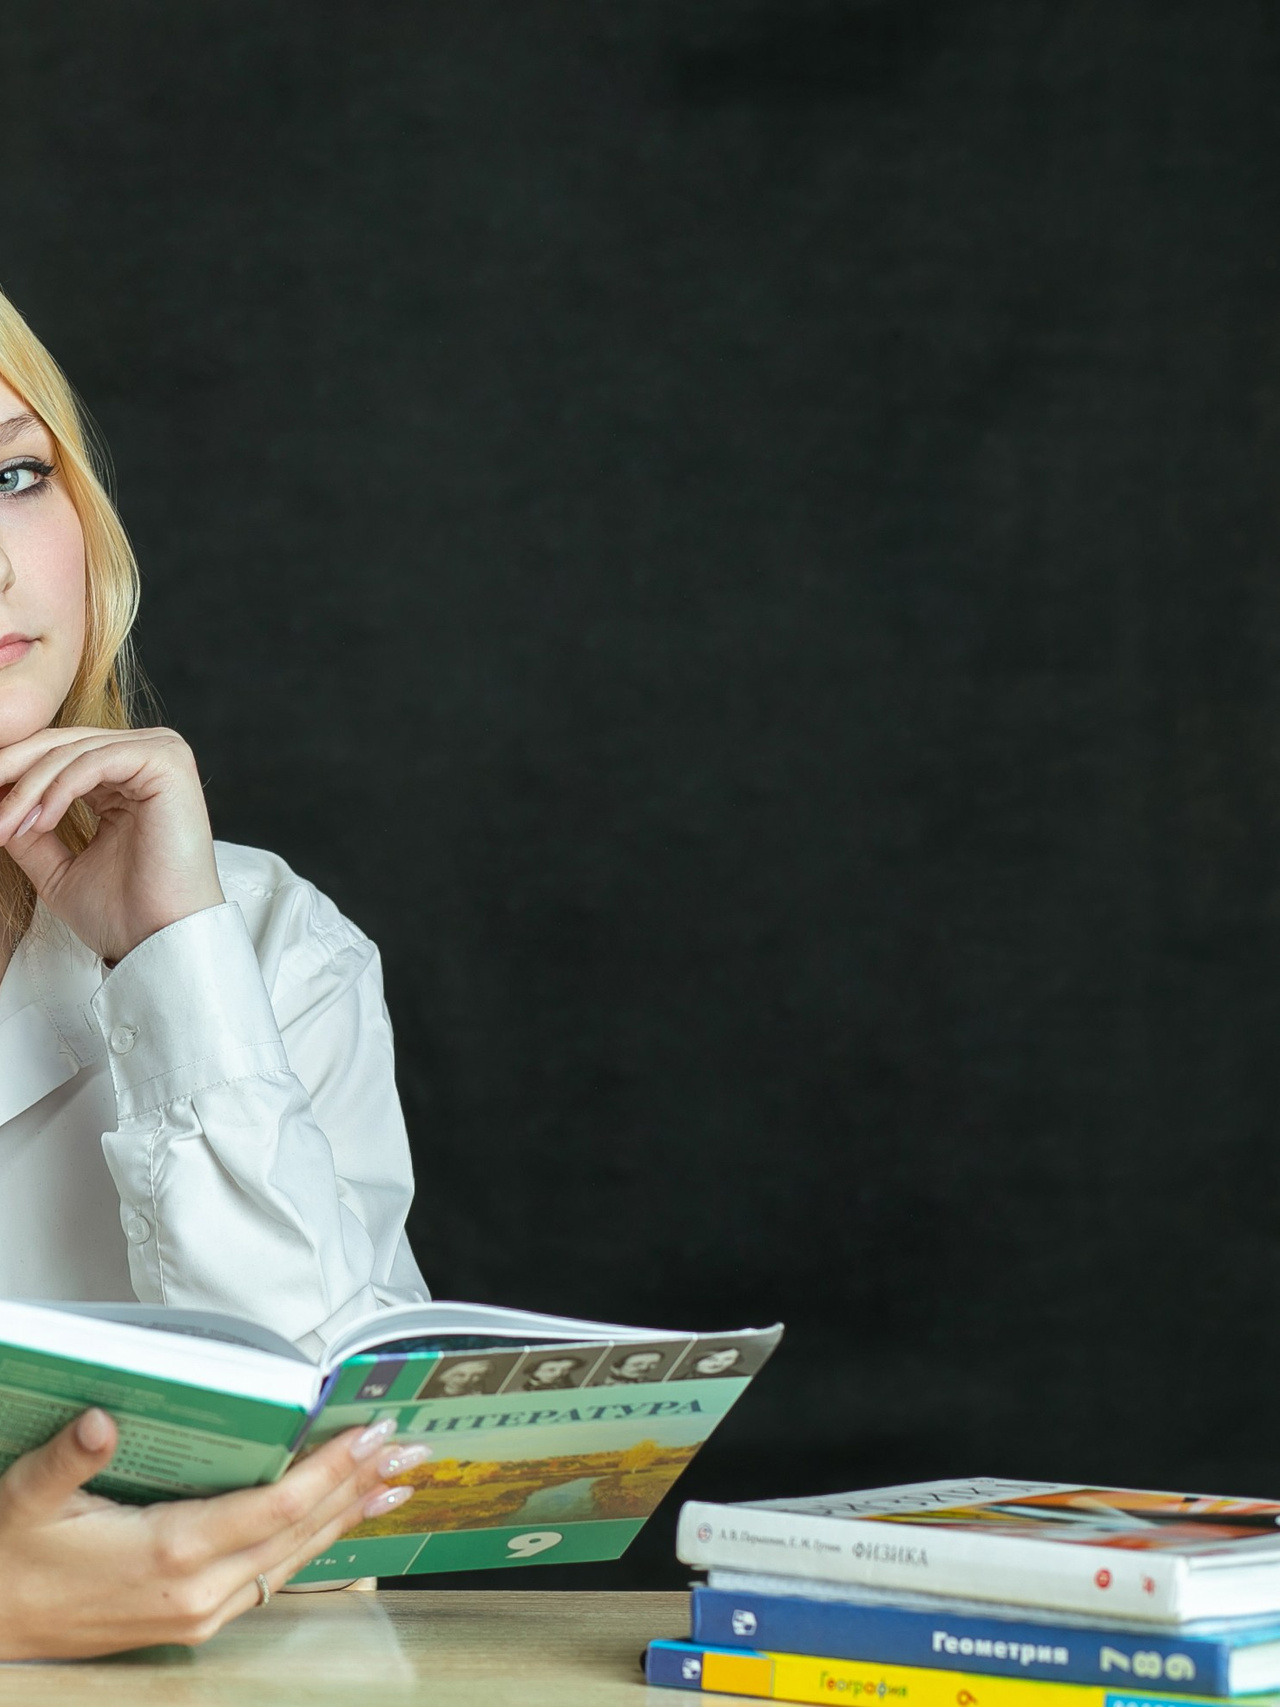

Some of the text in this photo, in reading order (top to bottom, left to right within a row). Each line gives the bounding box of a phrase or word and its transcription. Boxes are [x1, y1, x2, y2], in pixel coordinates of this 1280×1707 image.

[505, 1531, 563, 1559] 9
[852, 1540, 929, 1567] ФИЗИКА
[932, 1630, 1069, 1667] Геометрия
[820, 1671, 908, 1700] География
